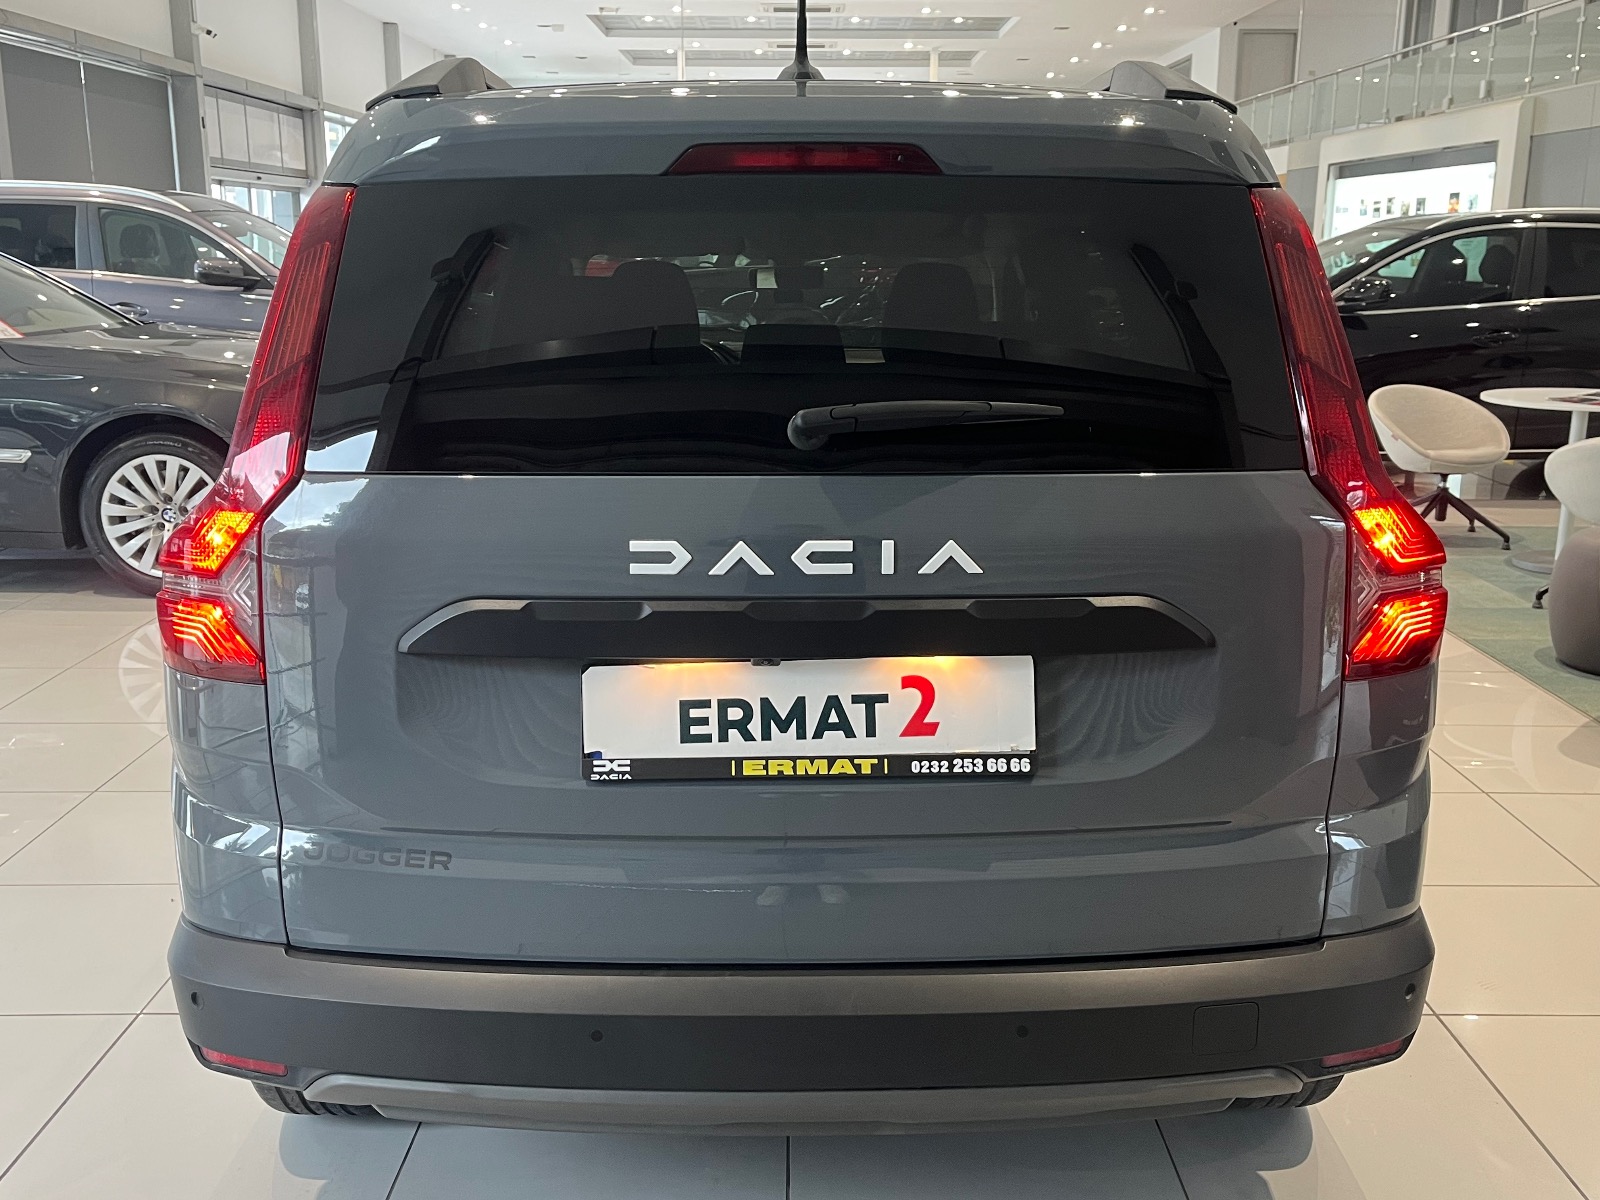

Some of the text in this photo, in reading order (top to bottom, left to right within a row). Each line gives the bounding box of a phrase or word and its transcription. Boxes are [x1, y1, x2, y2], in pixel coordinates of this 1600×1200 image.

[629, 539, 984, 576] DACIA
[678, 674, 940, 744] ERMAT 2
[590, 773, 632, 781] DACIA
[742, 758, 878, 776] ERMAT
[911, 757, 1031, 774] 0232 253 66 66
[303, 841, 453, 871] JOGGER
